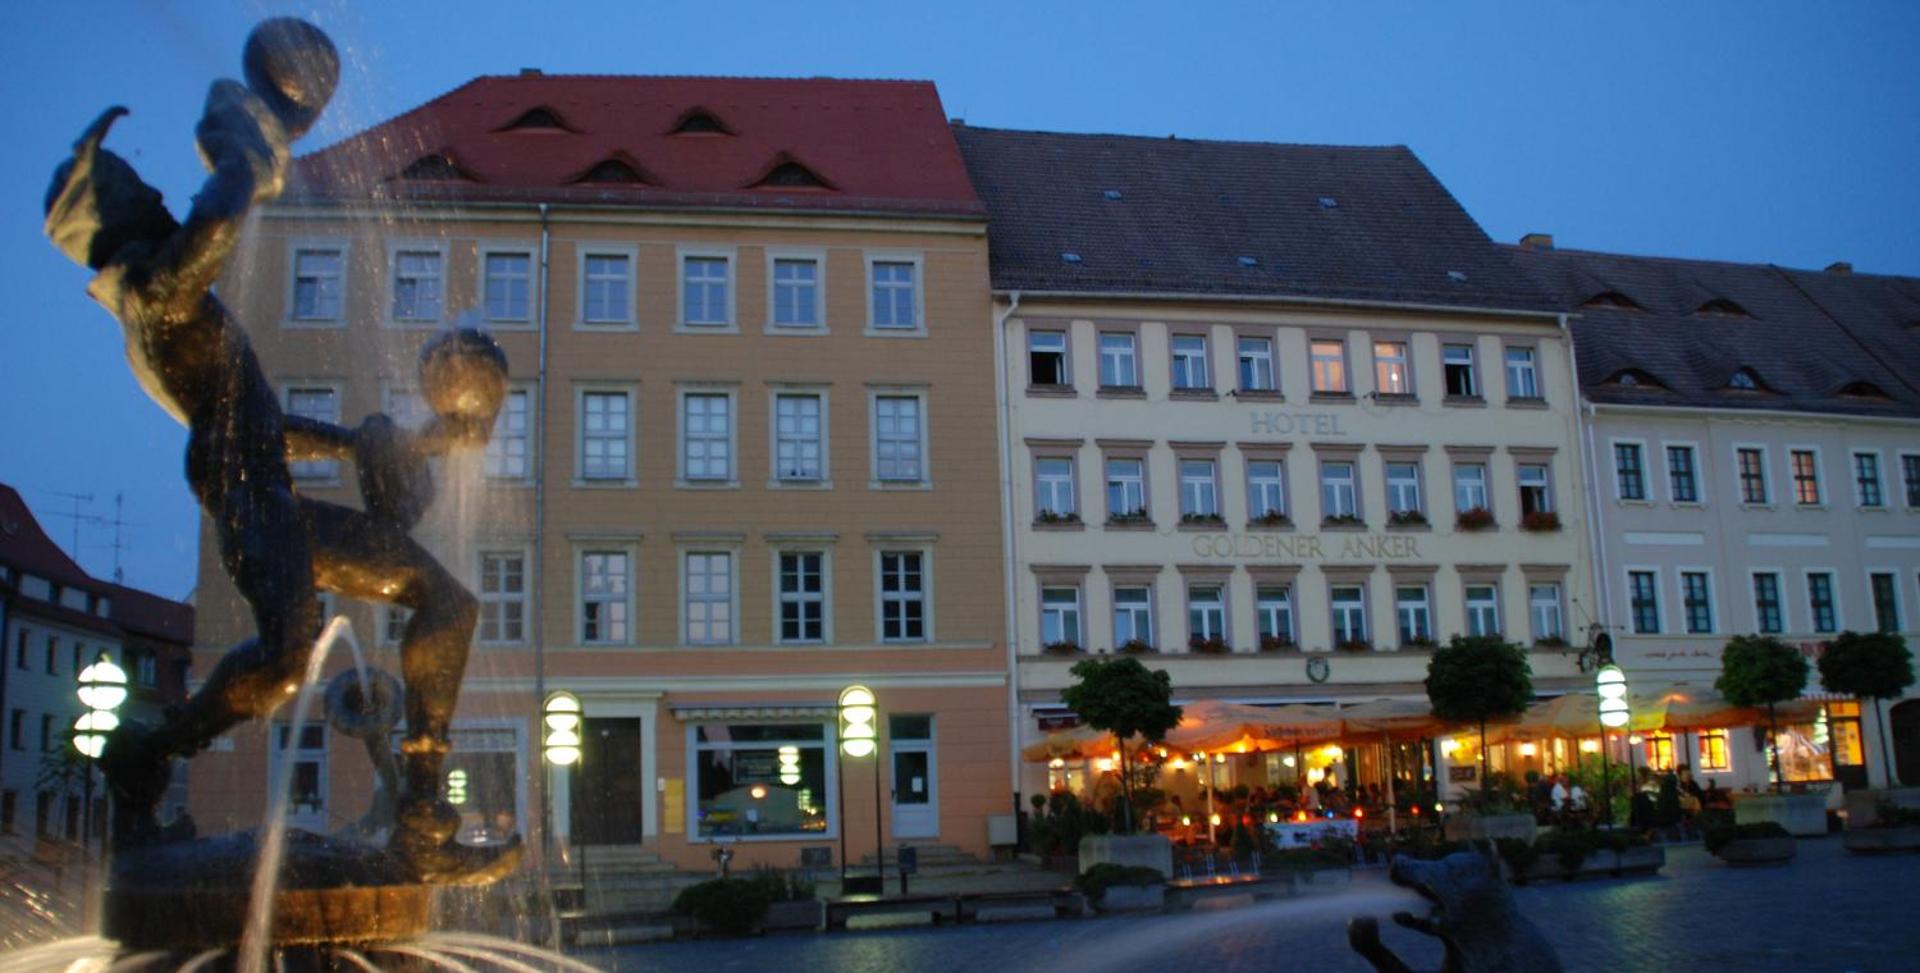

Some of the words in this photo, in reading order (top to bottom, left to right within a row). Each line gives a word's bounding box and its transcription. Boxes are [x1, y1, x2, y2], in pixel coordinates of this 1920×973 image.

[1252, 411, 1347, 435] HOTEL
[1193, 535, 1325, 559] GOLDENER
[1342, 536, 1422, 558] ANKER
